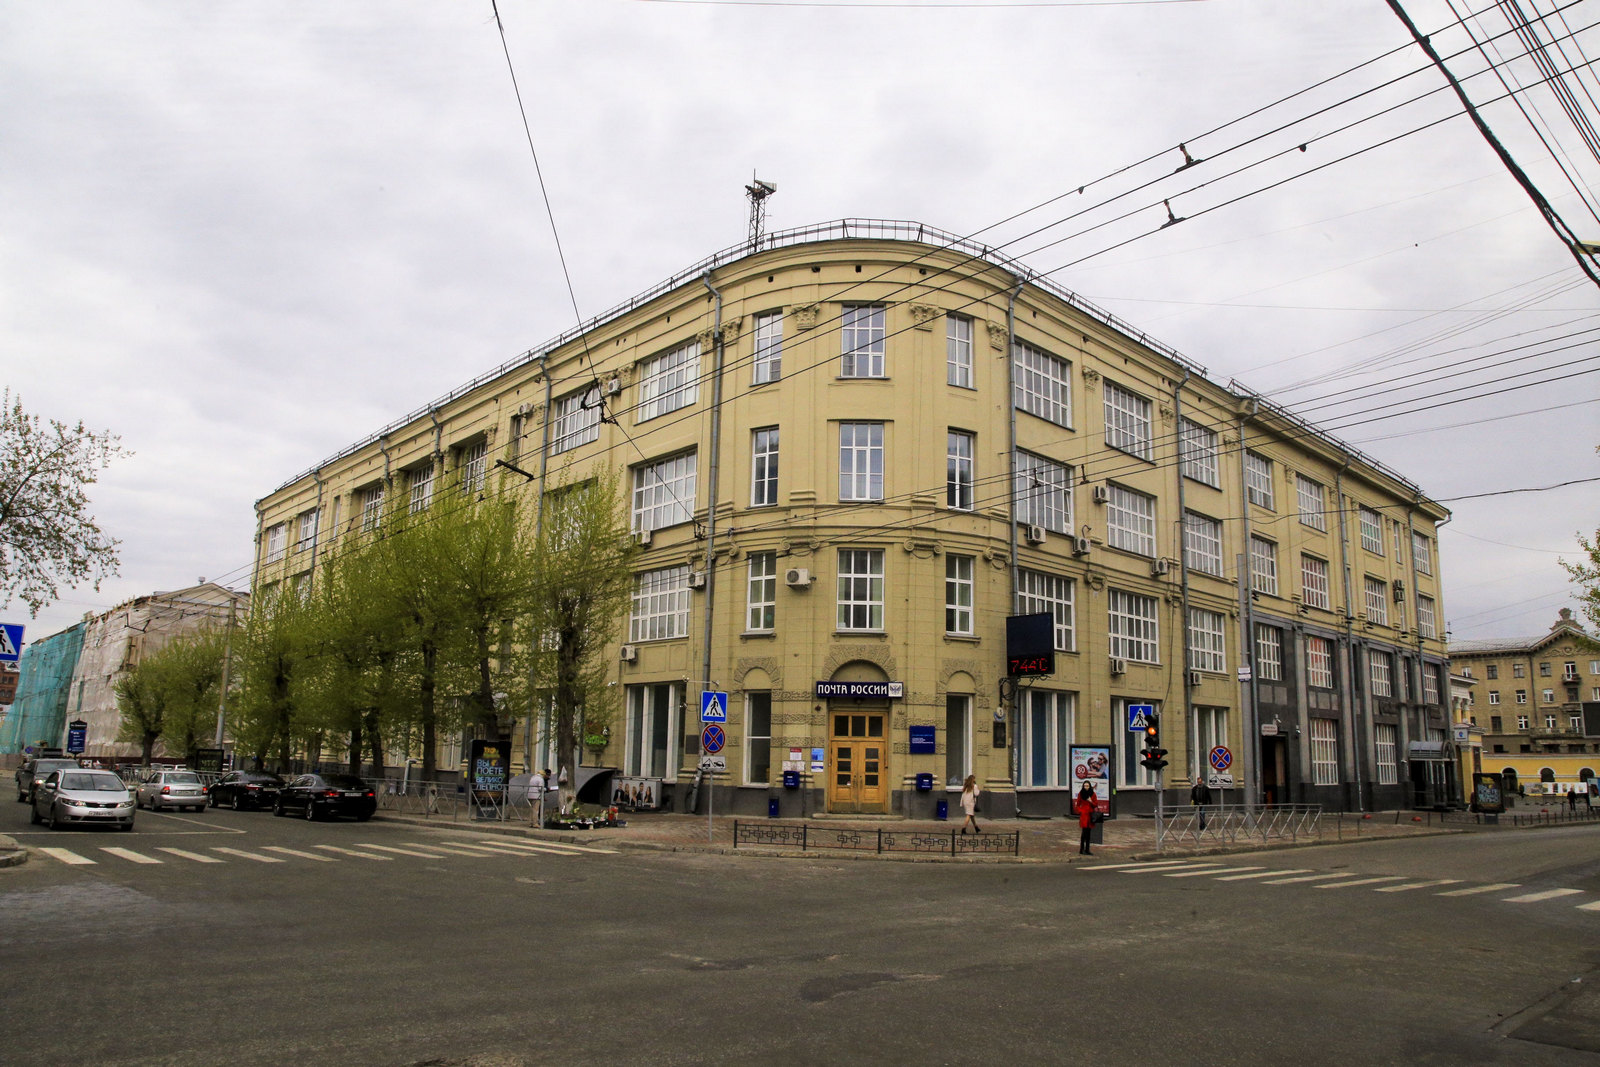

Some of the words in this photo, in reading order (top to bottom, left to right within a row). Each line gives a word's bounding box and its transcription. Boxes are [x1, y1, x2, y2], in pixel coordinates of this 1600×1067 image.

[818, 684, 847, 694] ПОЧТА
[850, 684, 887, 694] РОССИИ
[477, 759, 490, 767] ВЫ
[477, 767, 503, 775] ПОЕТЕ
